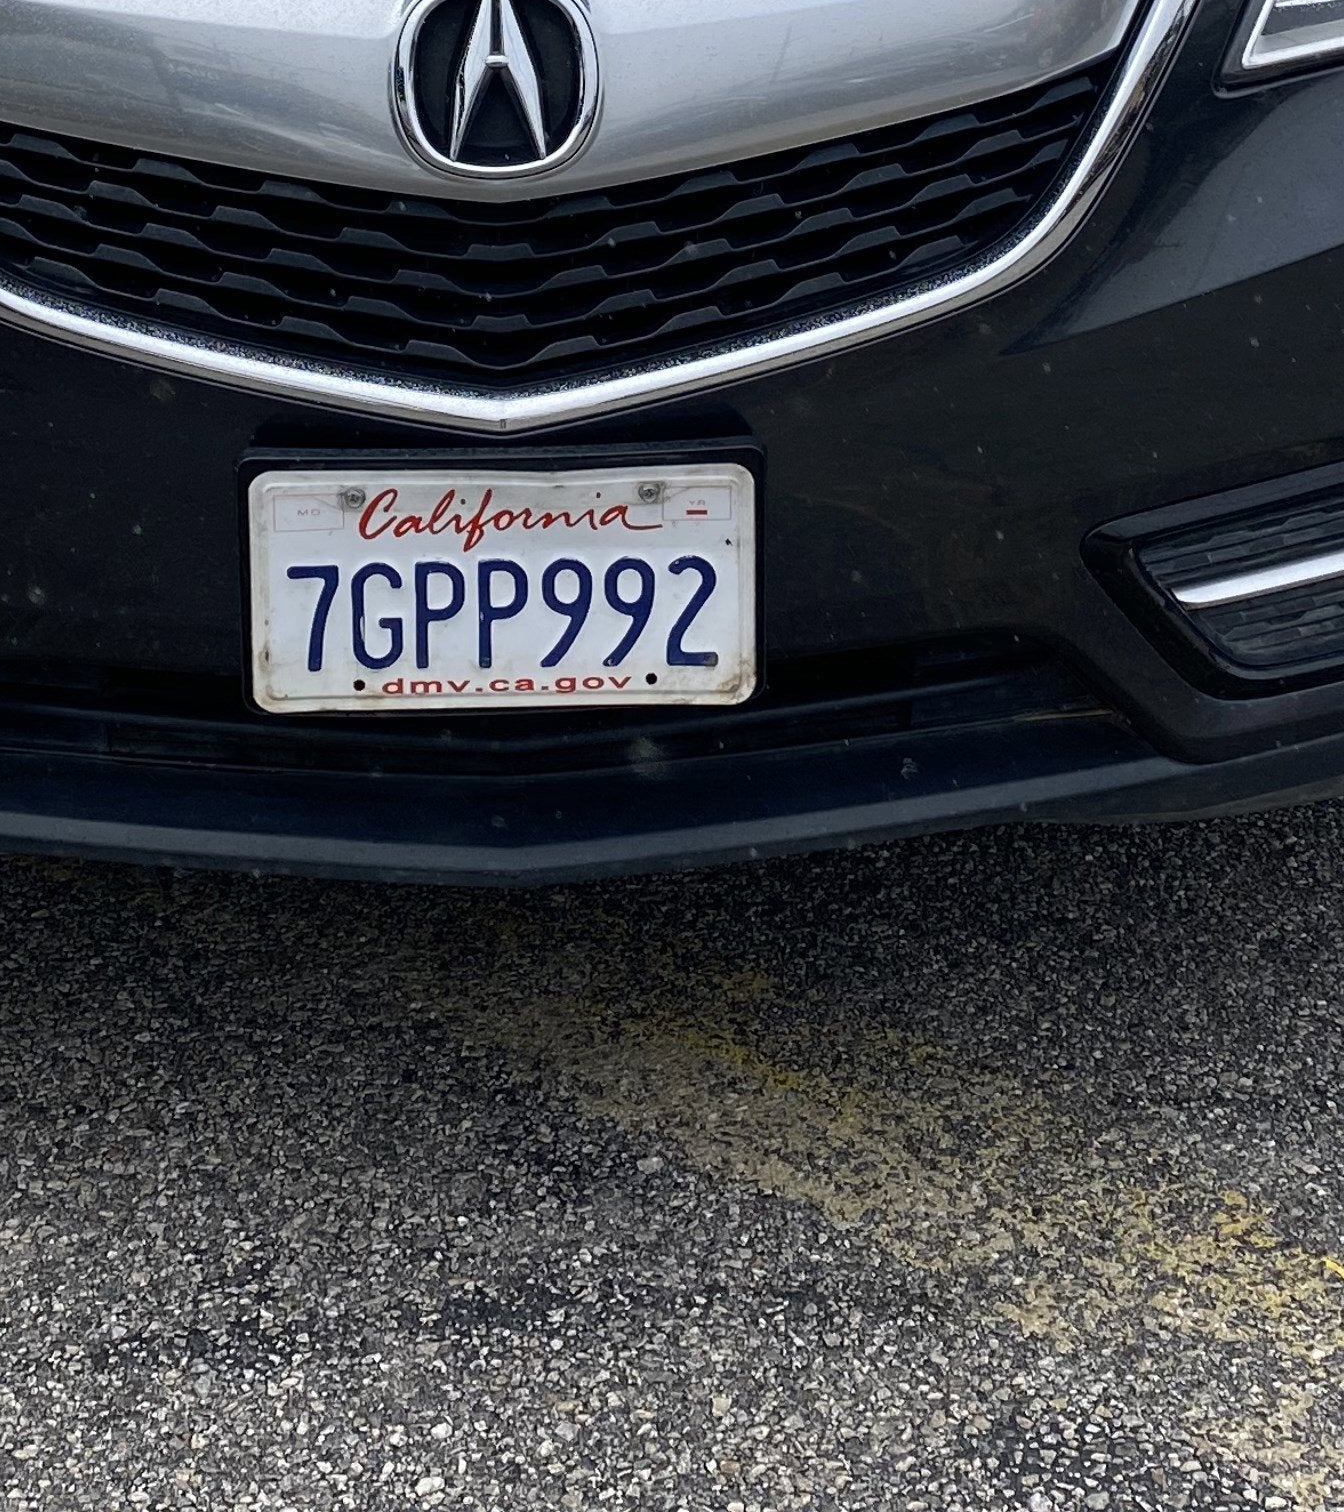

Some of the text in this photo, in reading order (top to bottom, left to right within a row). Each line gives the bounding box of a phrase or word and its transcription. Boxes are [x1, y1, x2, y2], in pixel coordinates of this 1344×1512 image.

[297, 508, 322, 517] MO
[359, 489, 664, 552] California
[286, 555, 719, 672] 7GPP992
[381, 672, 633, 696] dmv.ca.gov
